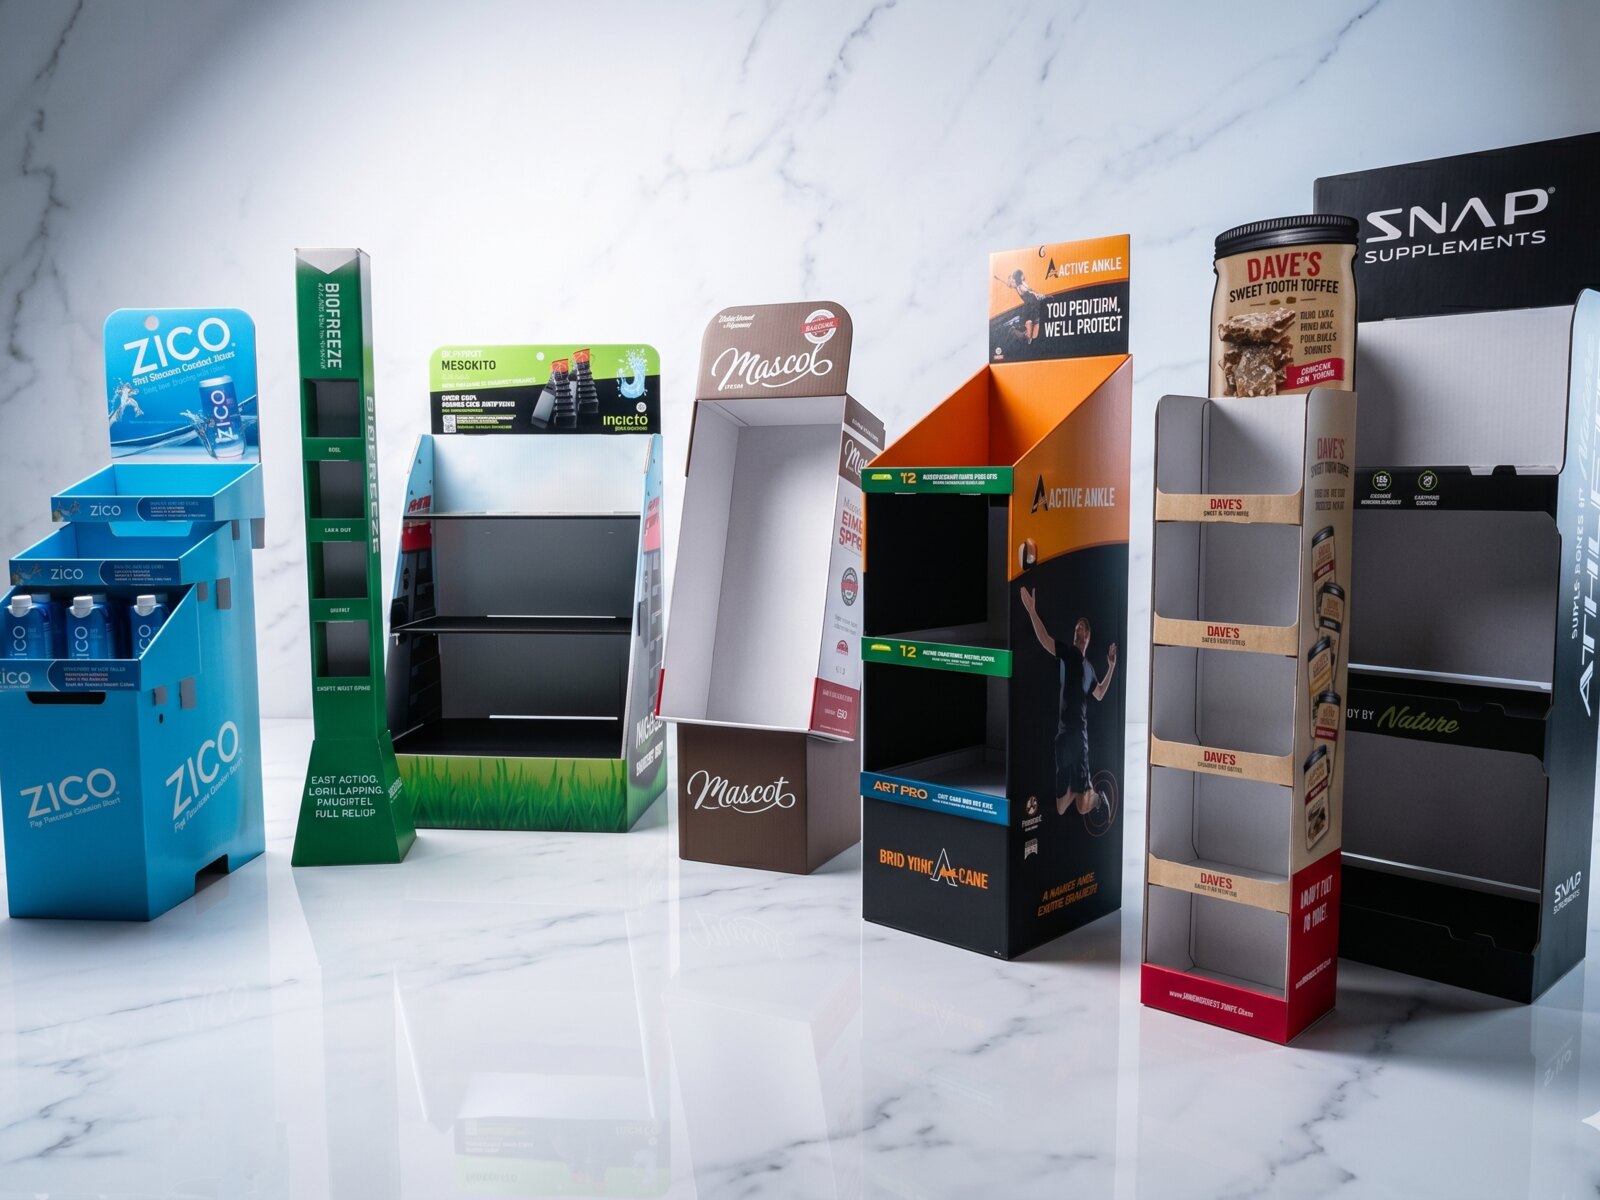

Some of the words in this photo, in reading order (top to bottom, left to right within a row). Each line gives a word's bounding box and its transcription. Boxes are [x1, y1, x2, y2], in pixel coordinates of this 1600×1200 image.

[1366, 188, 1549, 243] SNAP
[1364, 230, 1546, 264] SUPPLEMENTS
[1058, 261, 1089, 277] ACTIVE
[1092, 257, 1122, 272] ANKLE
[1247, 251, 1322, 283] DAVE'S
[1229, 283, 1262, 303] SWEET
[1265, 279, 1298, 294] TOOTH
[1300, 279, 1339, 294] TOFFEE
[1047, 302, 1067, 318] YOU
[325, 283, 342, 368] BIOFREEZE
[1045, 320, 1074, 338] WE'LL
[1077, 316, 1122, 335] PROTECT
[1049, 488, 1082, 508] ACTIVE
[1084, 488, 1115, 507] ANKLE
[1210, 499, 1242, 510] DAVE'S
[1207, 625, 1240, 639] DAVE'S
[0, 670, 31, 684] ICO
[1362, 709, 1374, 720] BY
[1377, 705, 1460, 733] Nature
[165, 720, 239, 820] ZICO
[311, 776, 336, 785] EAST
[20, 768, 116, 818] ZICO
[687, 770, 796, 814] Mascot
[873, 781, 898, 794] ART
[901, 786, 928, 799] PRO
[315, 809, 339, 818] FULL
[880, 849, 904, 868] BRID
